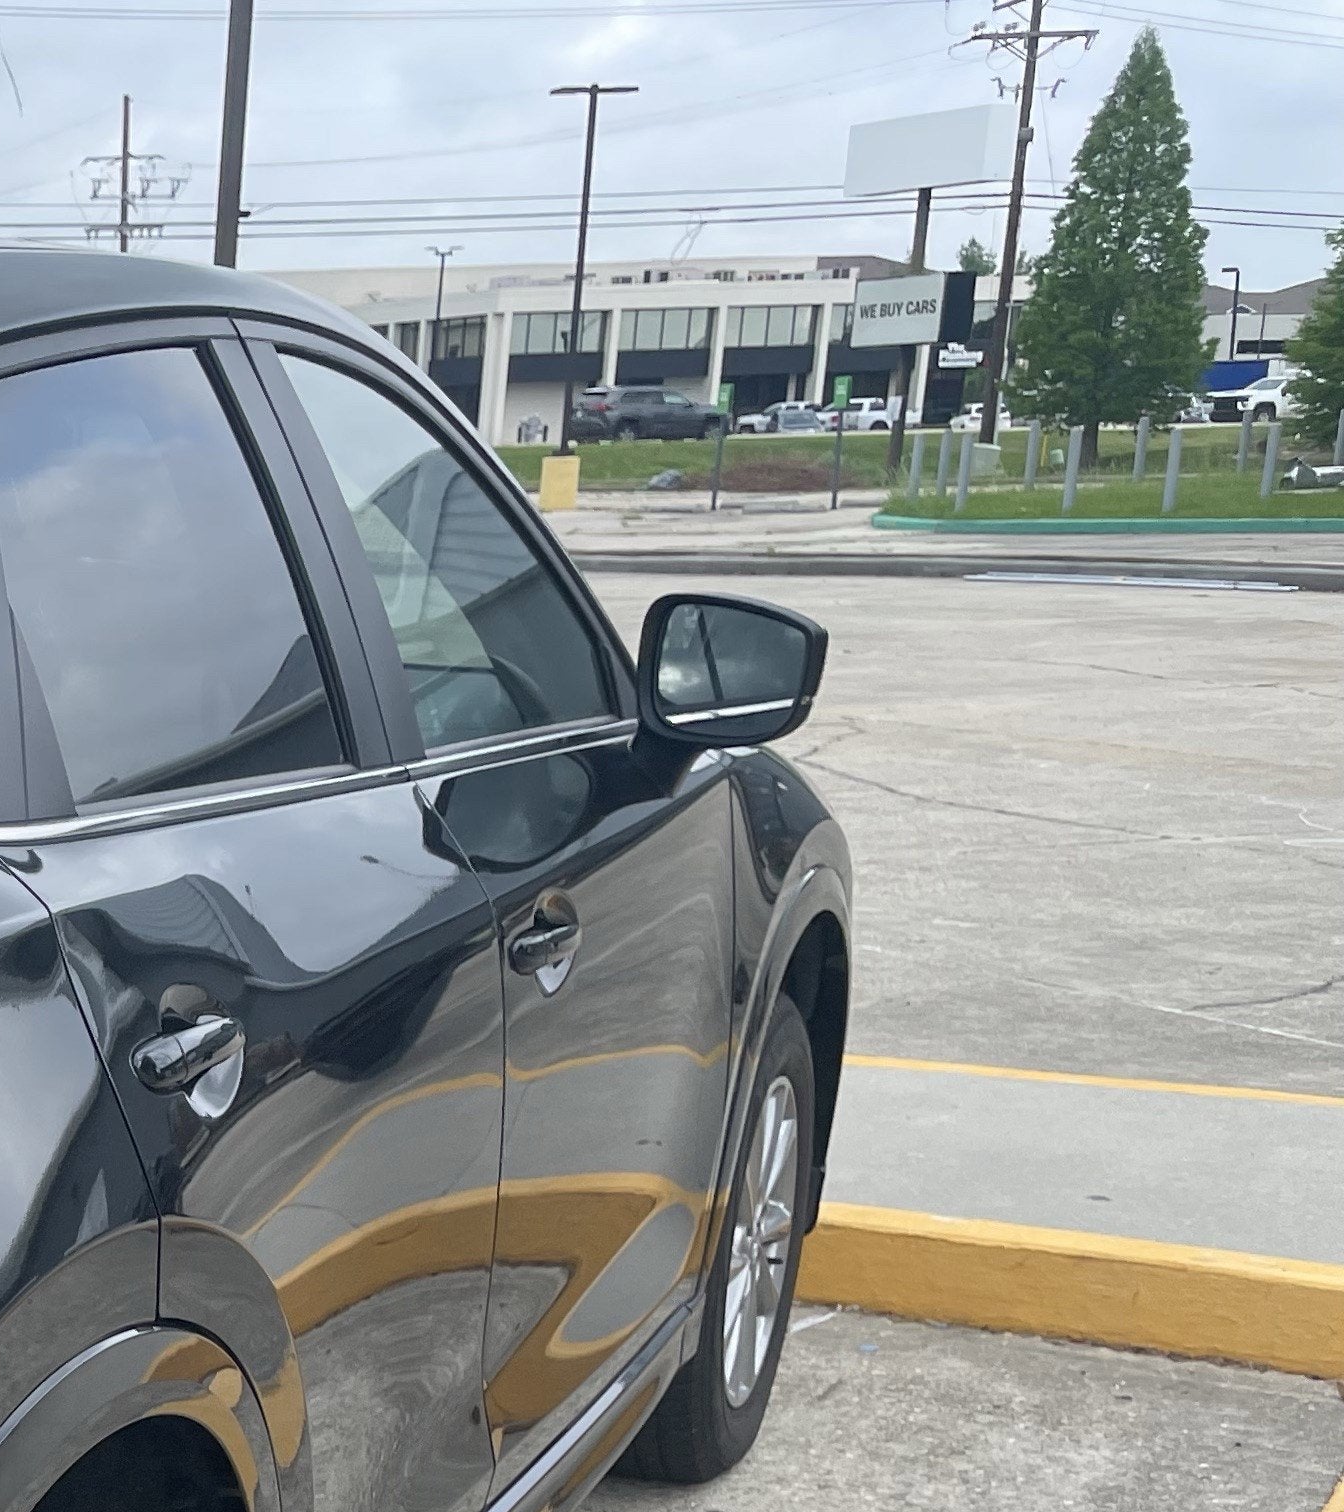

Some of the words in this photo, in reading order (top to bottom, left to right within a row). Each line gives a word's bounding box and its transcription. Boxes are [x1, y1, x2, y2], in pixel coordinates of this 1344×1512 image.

[860, 304, 877, 319] WE
[880, 302, 904, 318] BUY
[906, 299, 937, 316] CARS
